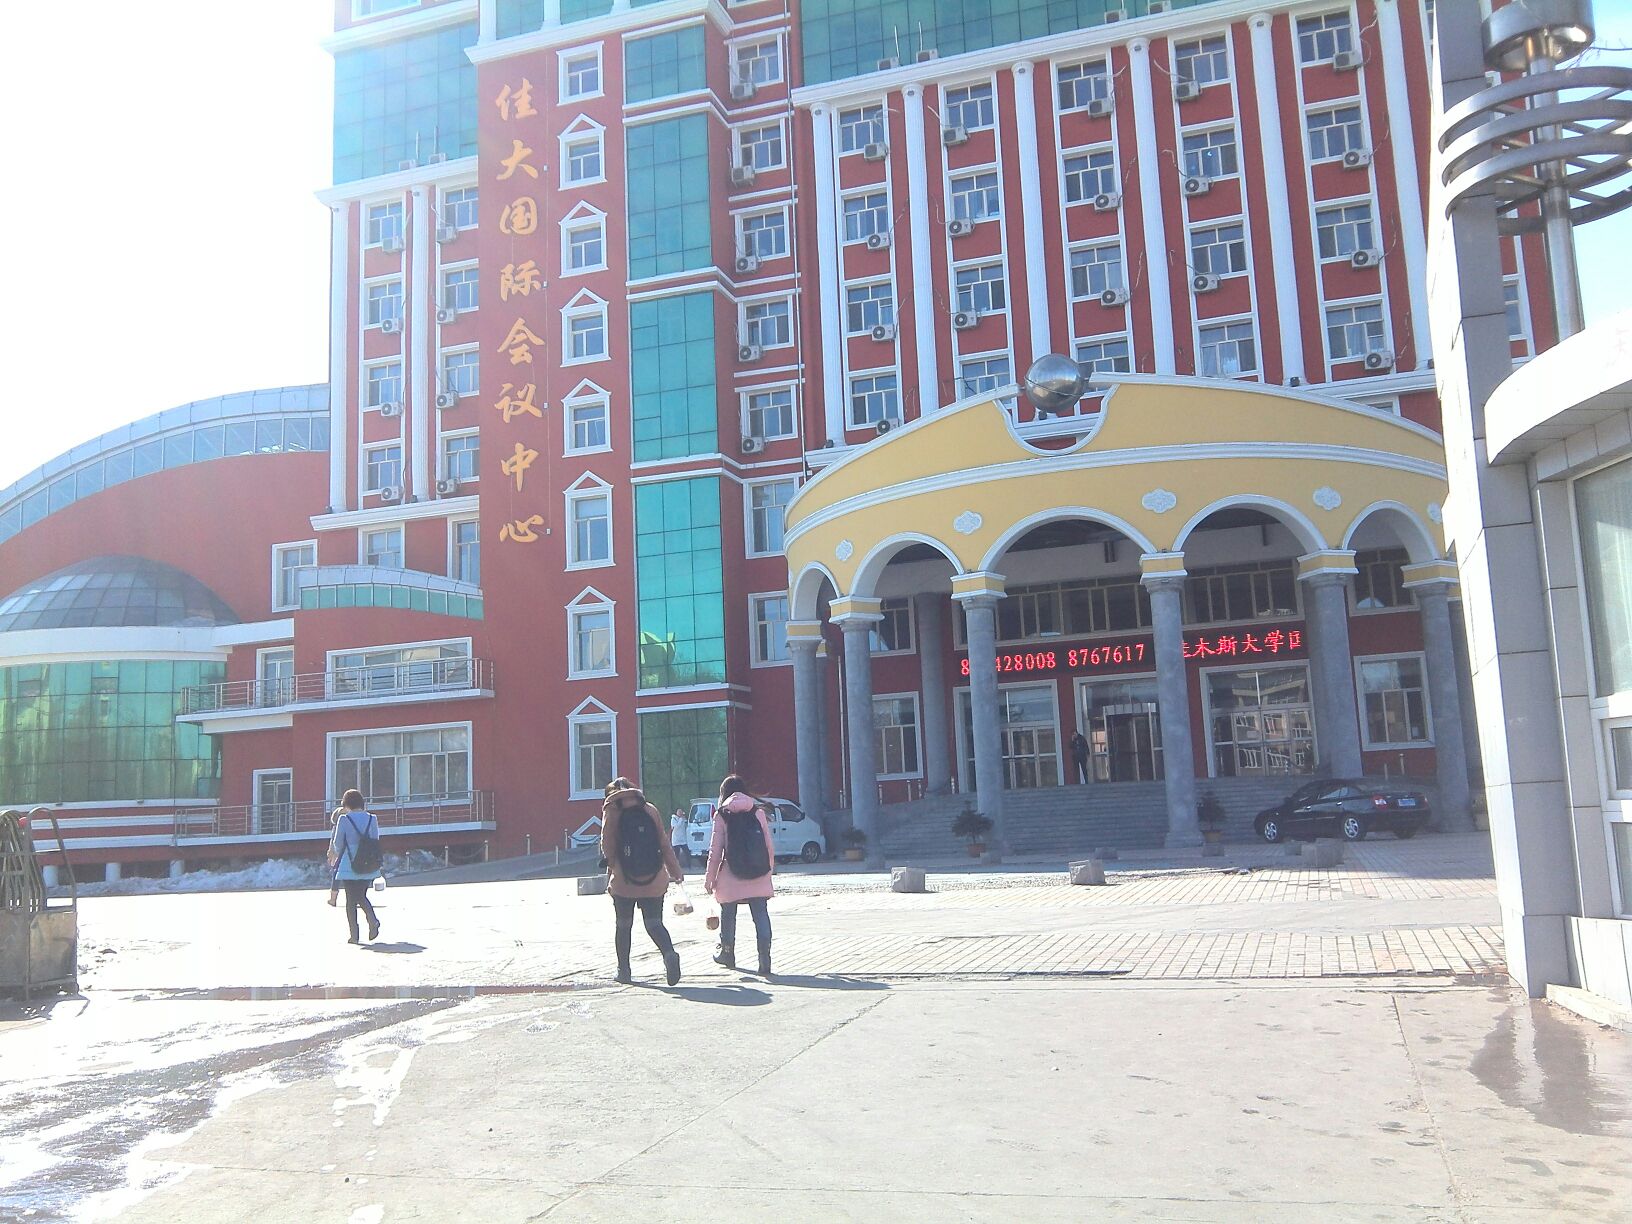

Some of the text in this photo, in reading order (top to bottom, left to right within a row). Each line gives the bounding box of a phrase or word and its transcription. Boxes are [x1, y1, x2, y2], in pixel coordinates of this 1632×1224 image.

[494, 76, 546, 545] 佳大国际会议中心
[1068, 643, 1145, 667] 8767617
